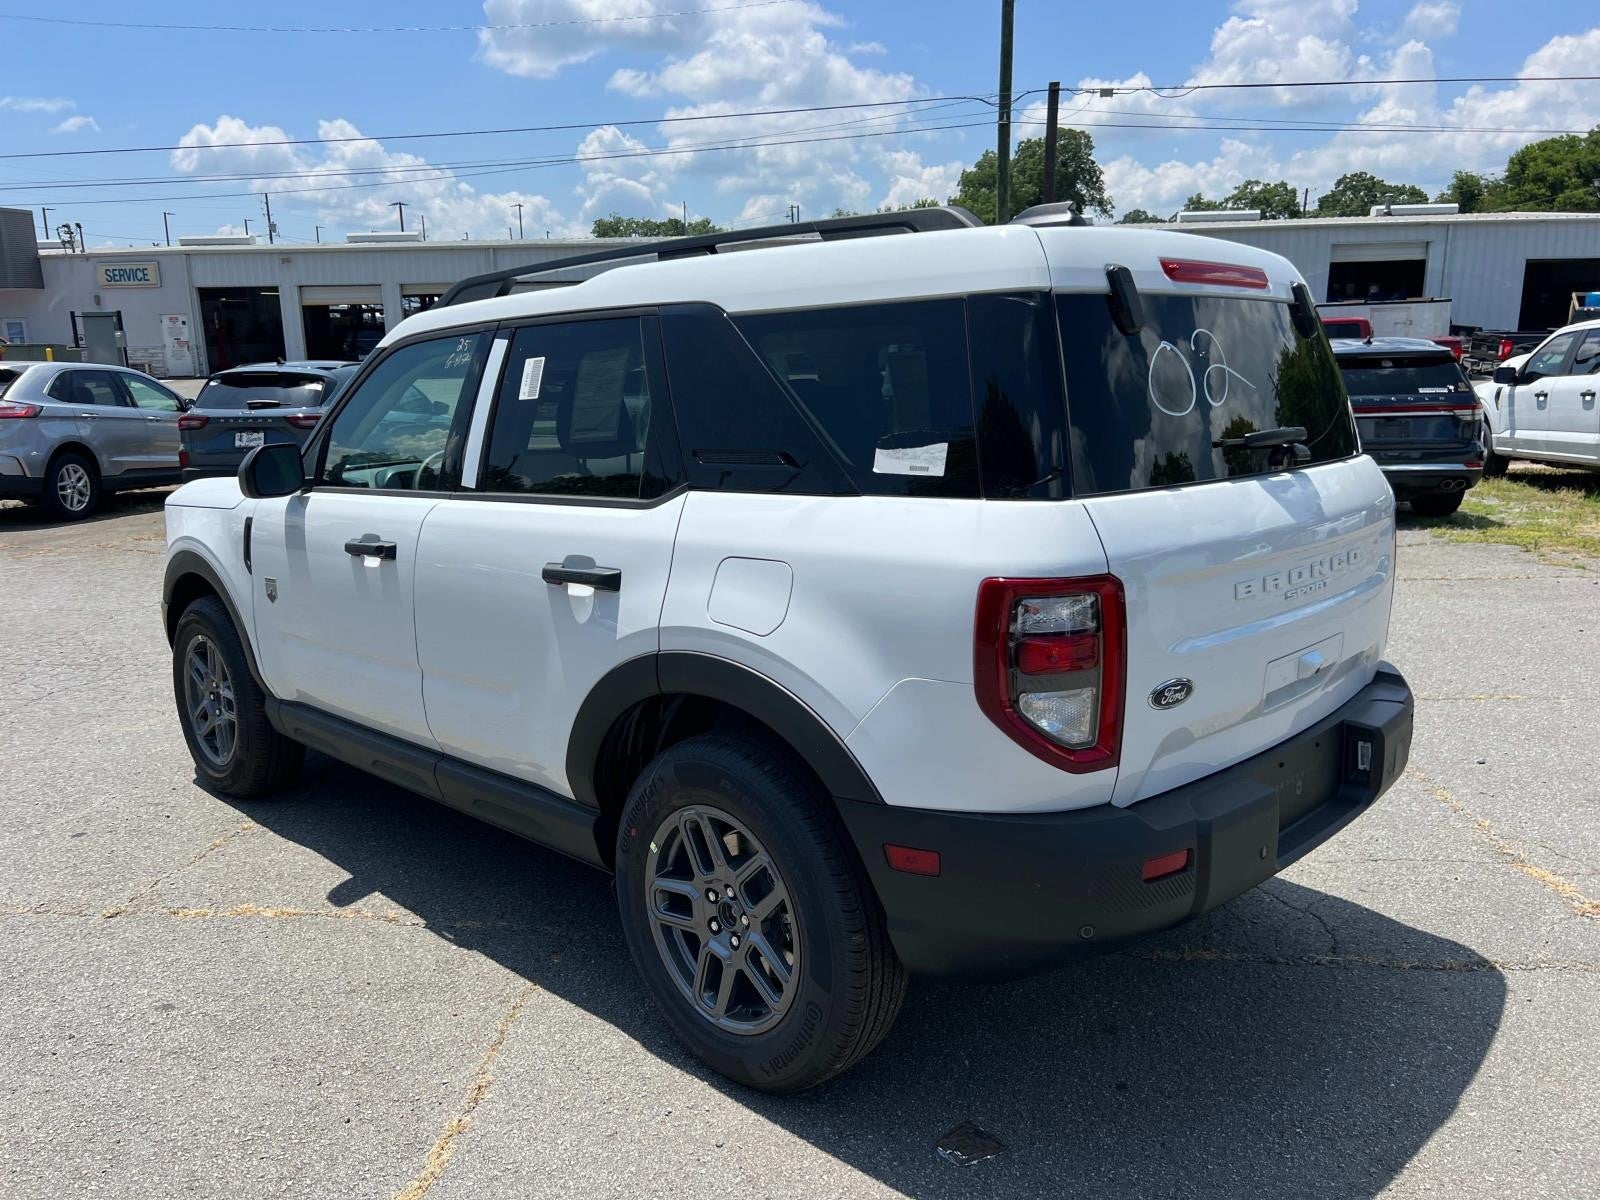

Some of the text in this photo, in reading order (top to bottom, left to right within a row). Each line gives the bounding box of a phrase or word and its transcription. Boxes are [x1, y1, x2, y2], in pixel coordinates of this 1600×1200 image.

[104, 267, 150, 282] SERVICE
[456, 337, 473, 352] 25
[1234, 547, 1364, 601] BRONCO
[1284, 577, 1328, 601] SPORT
[1161, 685, 1187, 704] Ford
[620, 778, 658, 854] Continental
[768, 1001, 824, 1075] Continental
